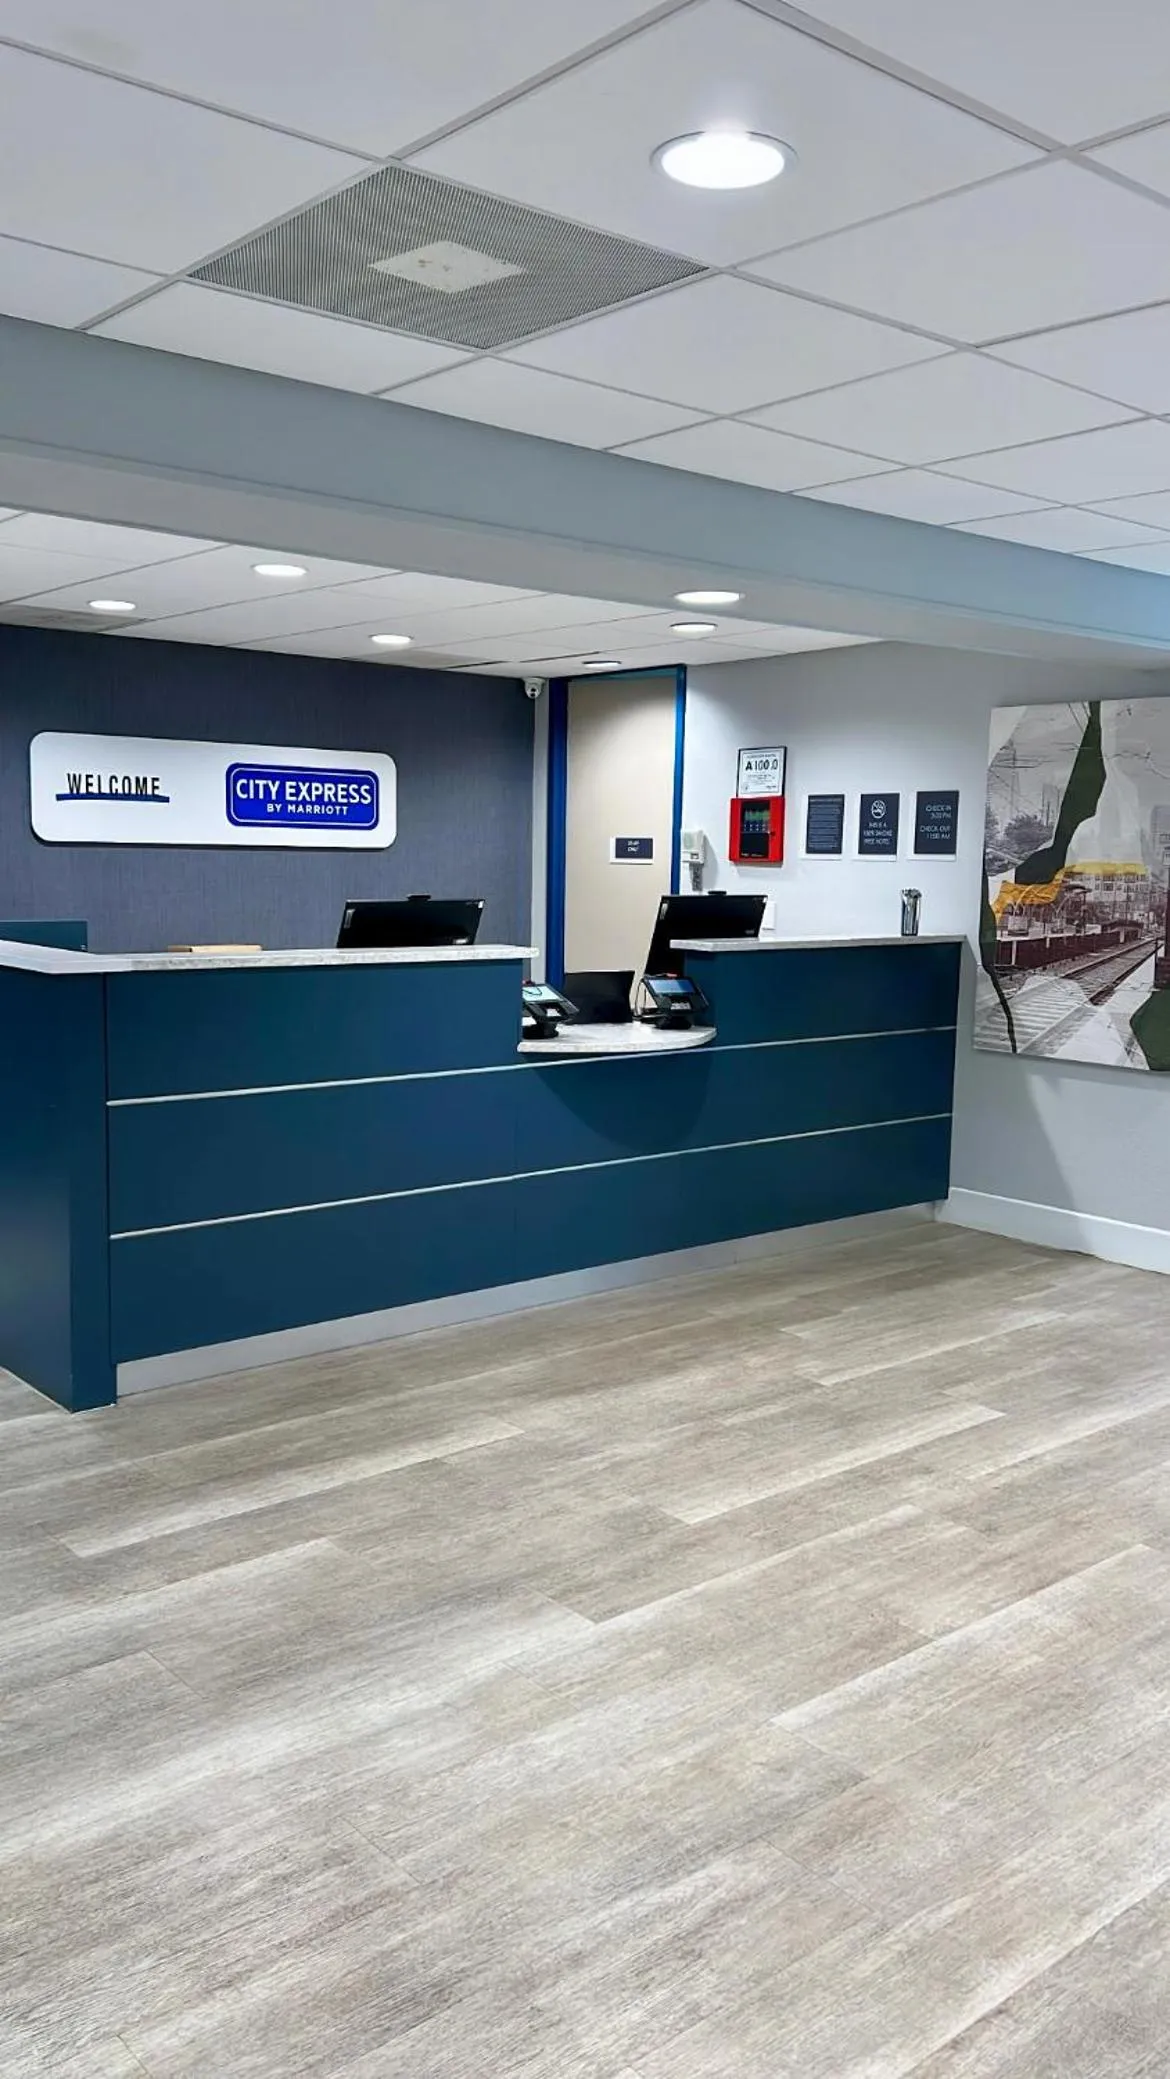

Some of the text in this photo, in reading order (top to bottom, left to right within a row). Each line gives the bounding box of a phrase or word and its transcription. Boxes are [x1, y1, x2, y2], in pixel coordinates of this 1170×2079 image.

[745, 760, 753, 771] A
[67, 773, 160, 796] WELCOME
[236, 778, 372, 805] CITY EXPRESS
[266, 803, 349, 816] BY MARRIOTT
